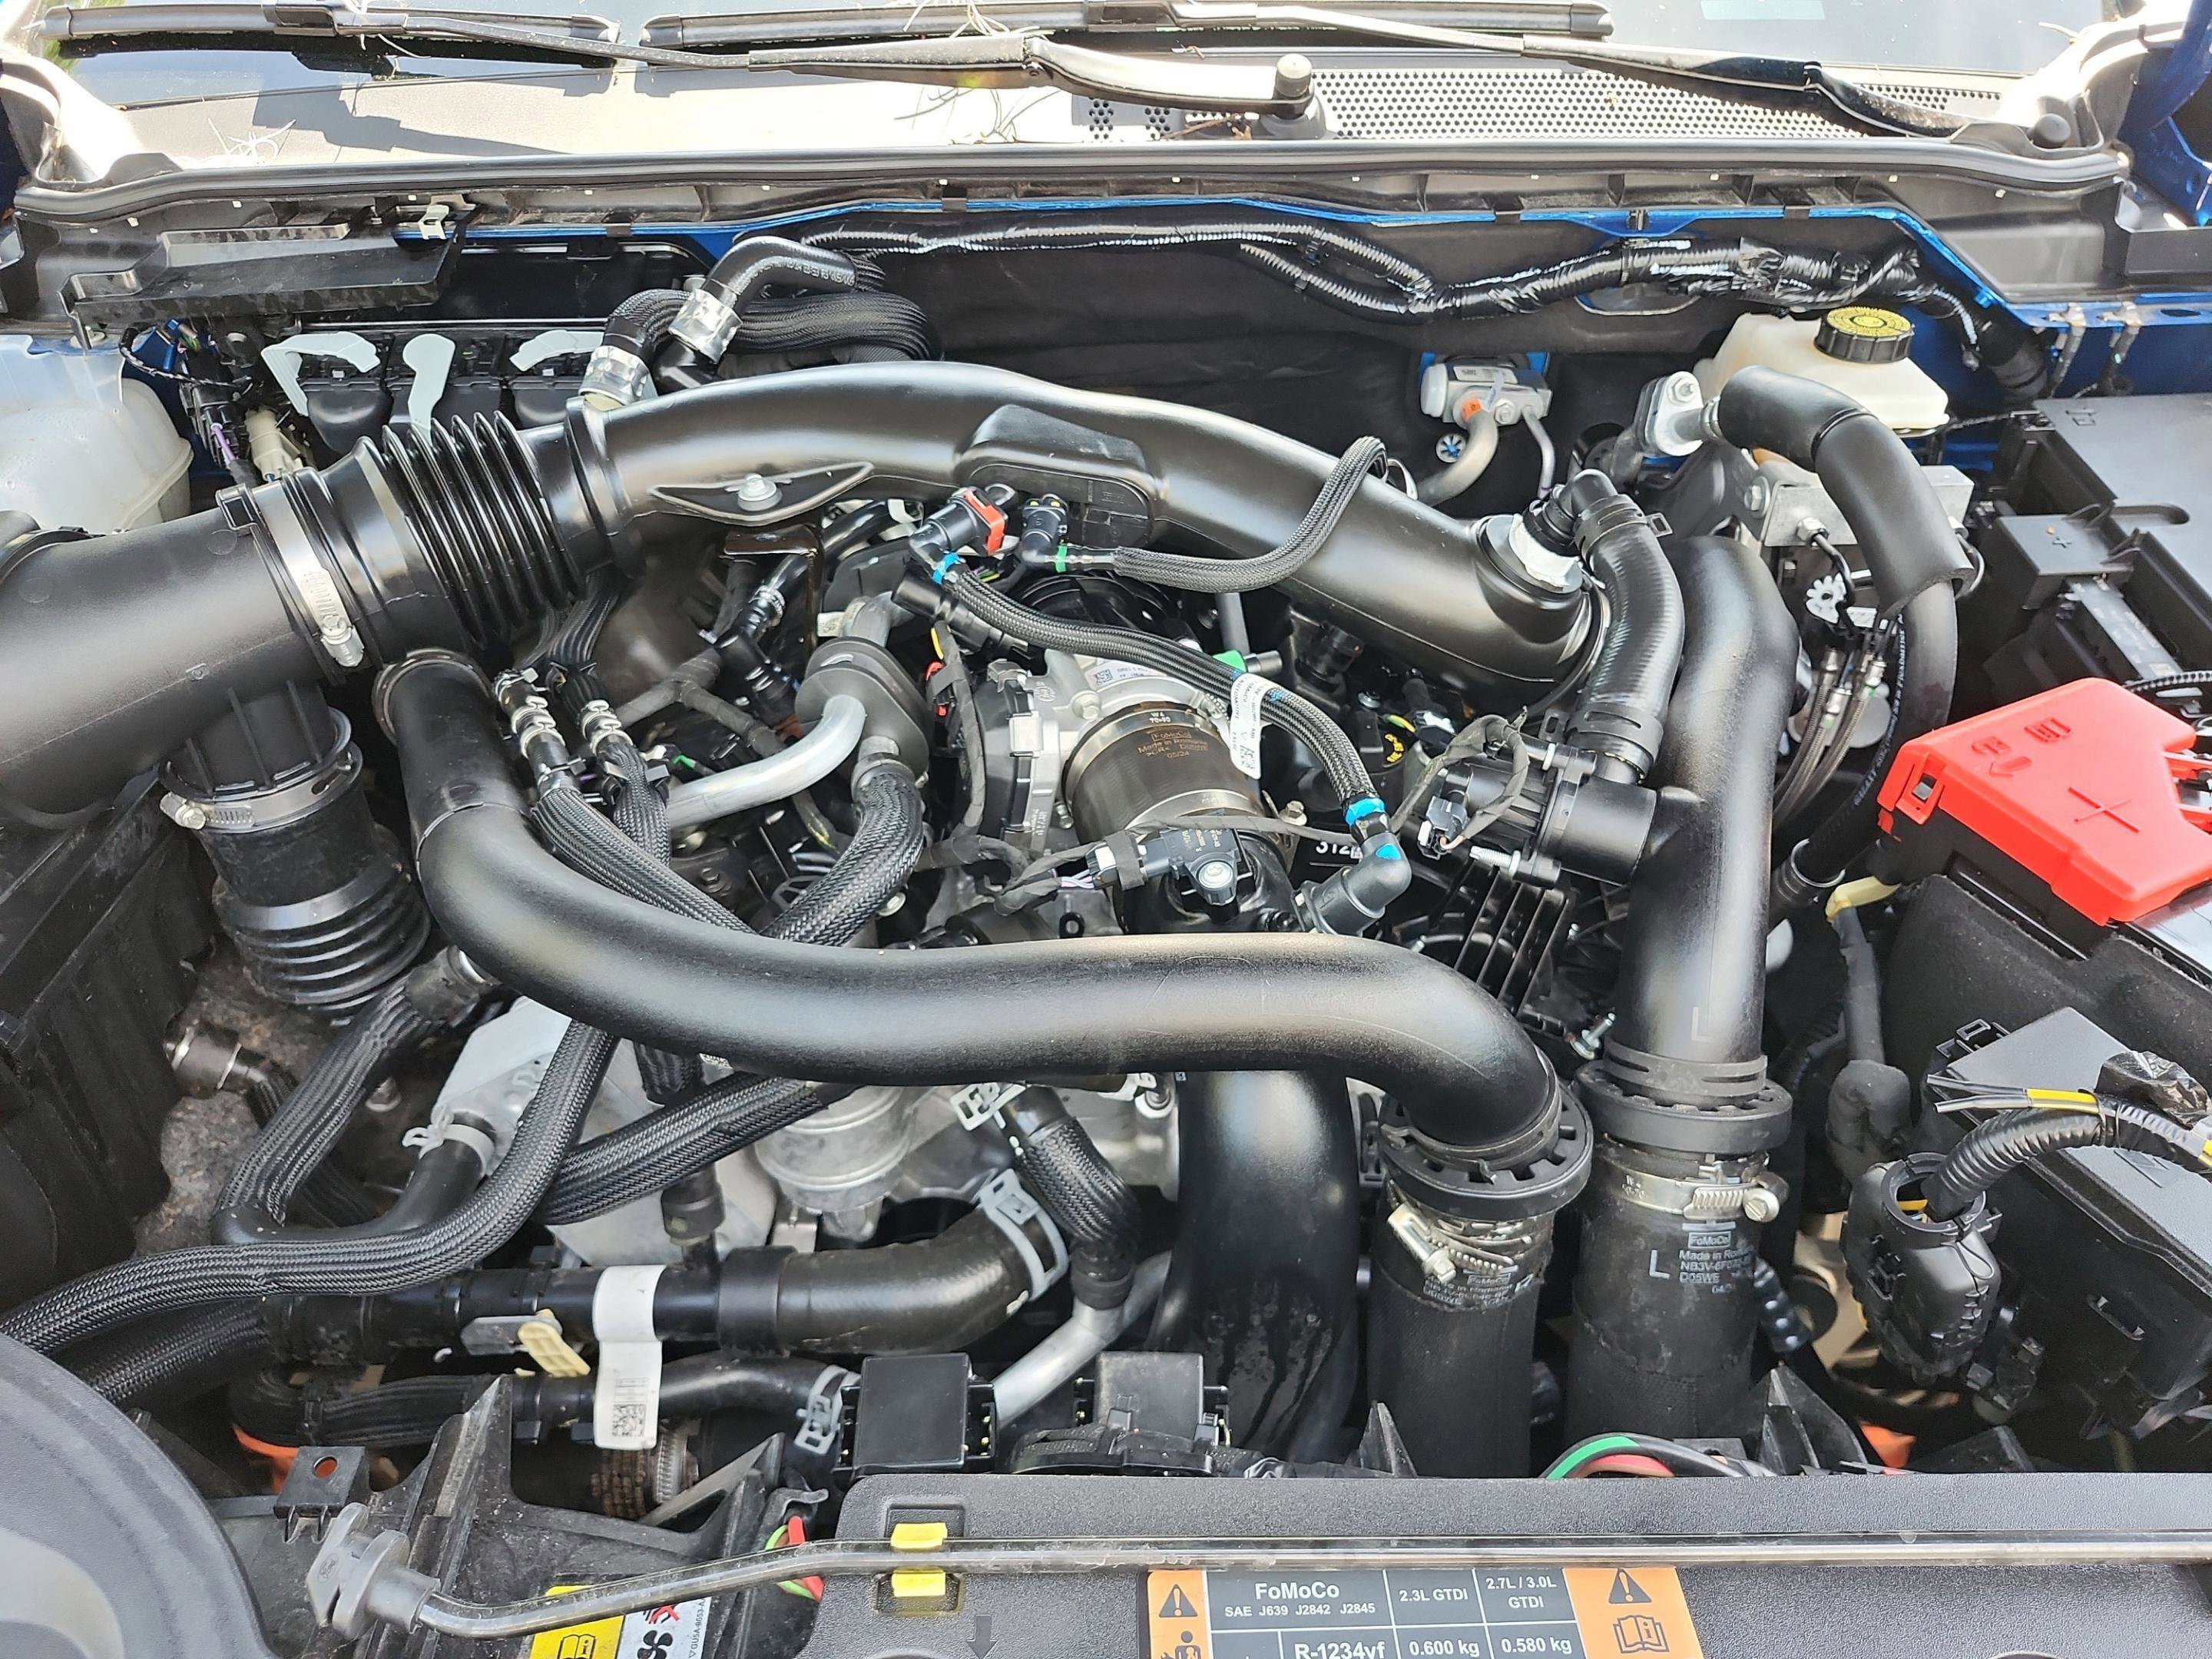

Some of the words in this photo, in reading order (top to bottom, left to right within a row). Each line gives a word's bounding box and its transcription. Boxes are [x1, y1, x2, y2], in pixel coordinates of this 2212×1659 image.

[1137, 742, 1162, 753] Made
[1679, 1250, 1710, 1262] Made
[1712, 1251, 1722, 1260] in
[1649, 1249, 1671, 1280] L
[1255, 1581, 1339, 1600] FoMoCo
[1485, 1577, 1517, 1590] 2.7L
[1526, 1576, 1557, 1588] 3.0L
[1399, 1590, 1430, 1602] 2.3L
[1432, 1588, 1469, 1601] GTDI
[1508, 1596, 1545, 1609] GTDI
[1224, 1606, 1253, 1618] SAE
[1259, 1604, 1289, 1617] J639
[1295, 1604, 1331, 1616] J2842
[1339, 1602, 1376, 1614] J2845
[1409, 1640, 1454, 1656] 0.600
[1458, 1639, 1480, 1657] kg
[1501, 1637, 1546, 1653] 0.580
[1550, 1637, 1573, 1654] kg
